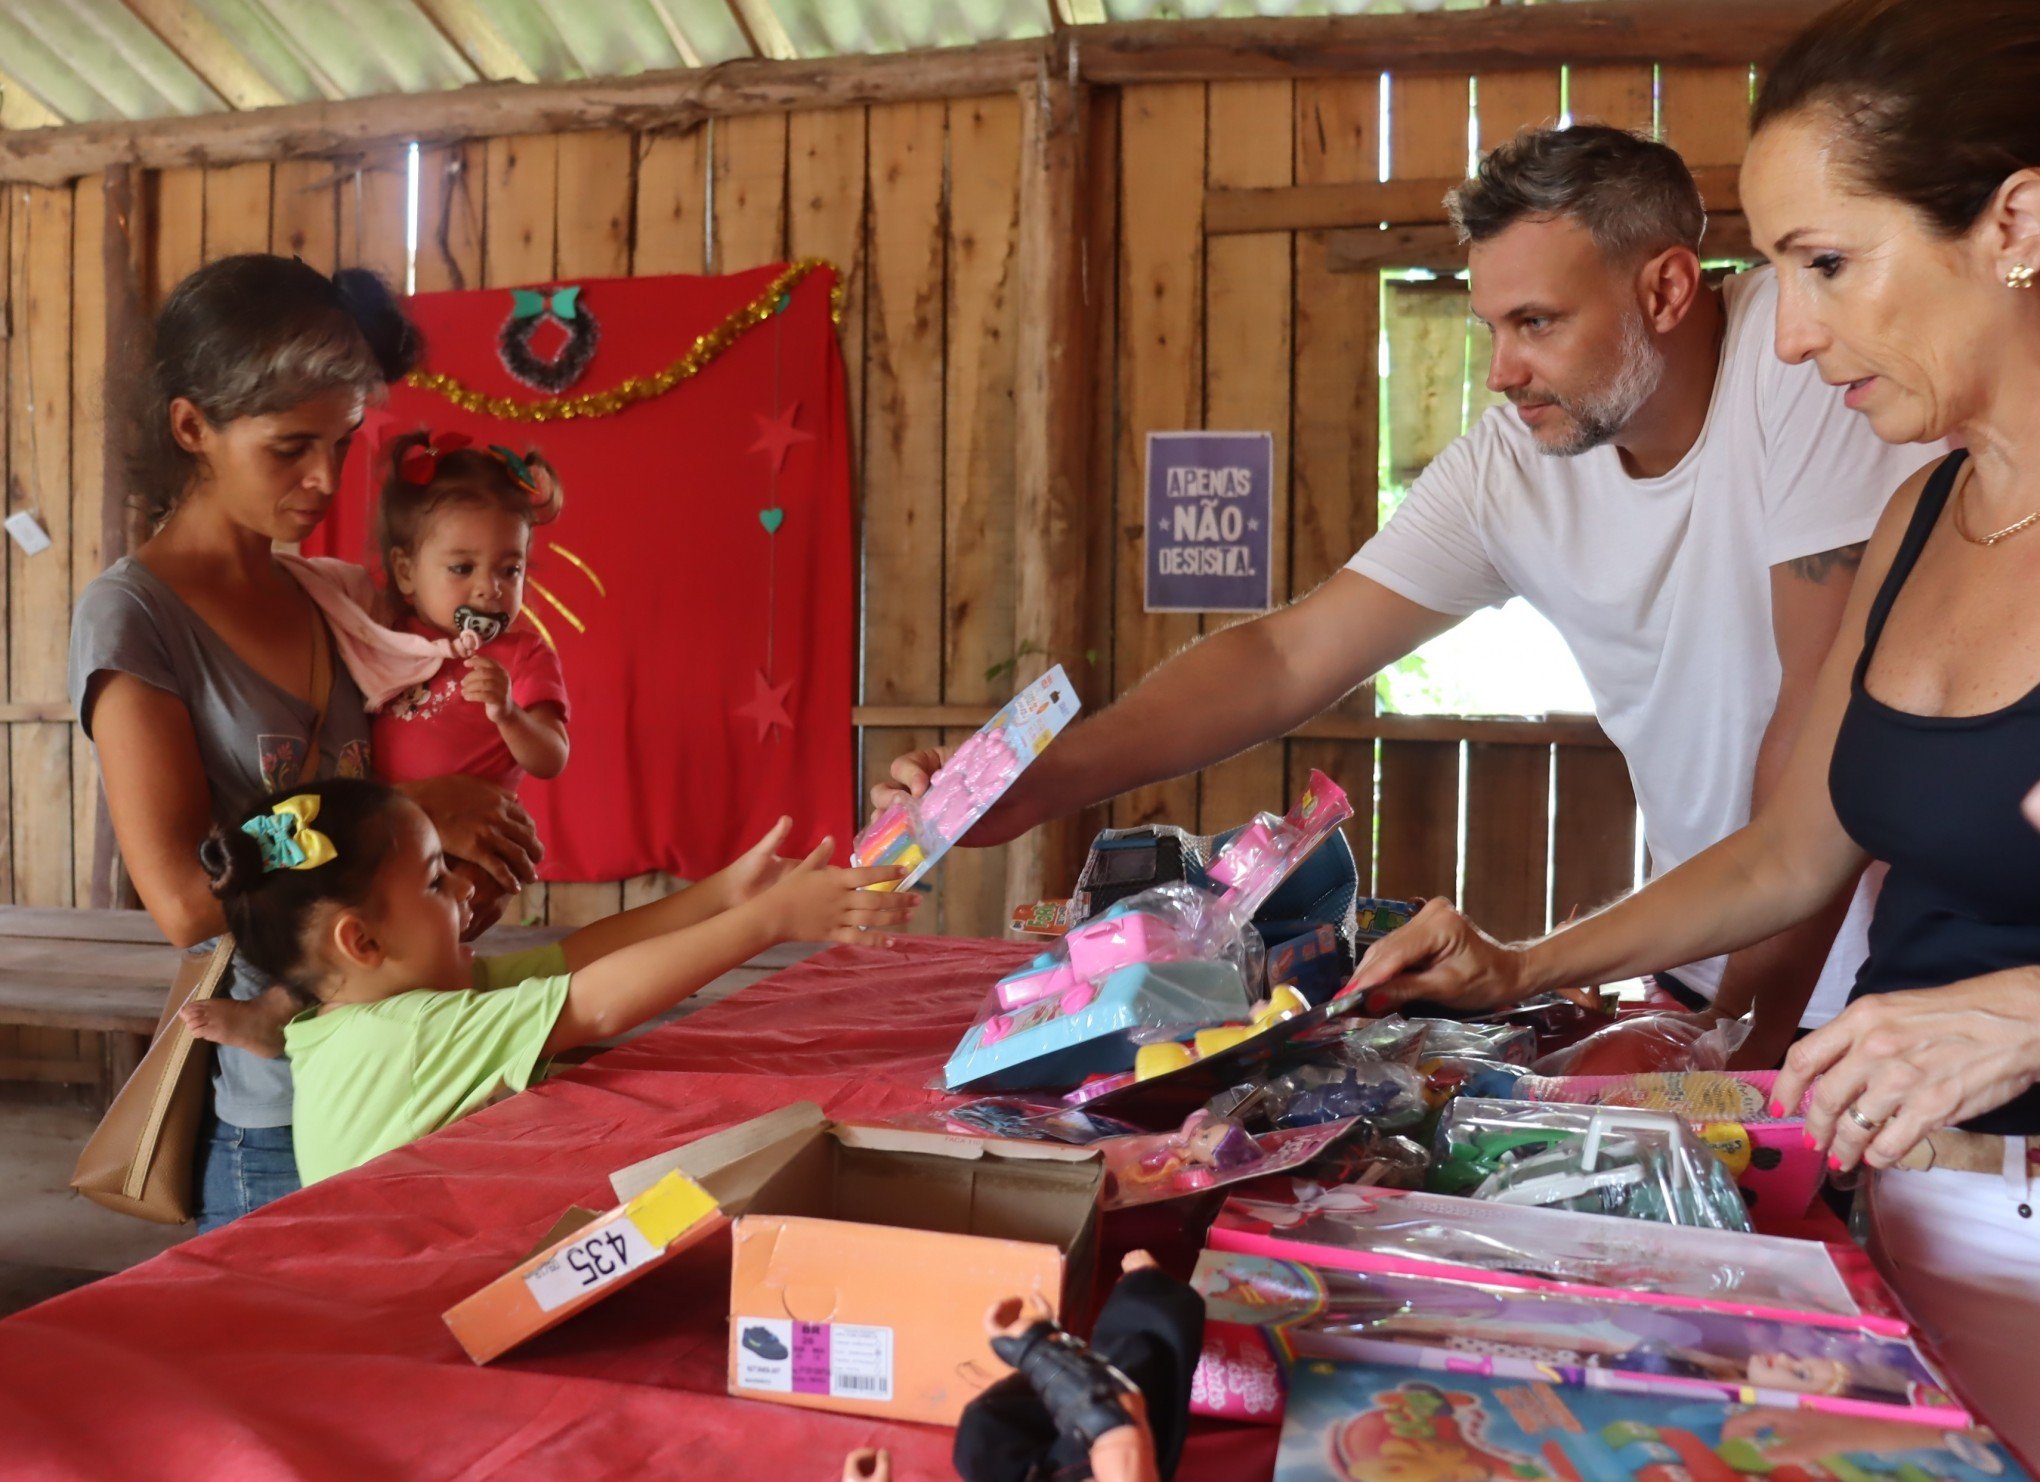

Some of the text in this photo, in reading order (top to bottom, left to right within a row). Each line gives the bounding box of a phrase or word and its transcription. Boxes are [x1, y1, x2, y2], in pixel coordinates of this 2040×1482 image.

[1167, 467, 1251, 498] APENAS
[1173, 499, 1243, 541] NÃO
[1159, 547, 1256, 576] DESISTA.
[566, 1231, 628, 1286] 435
